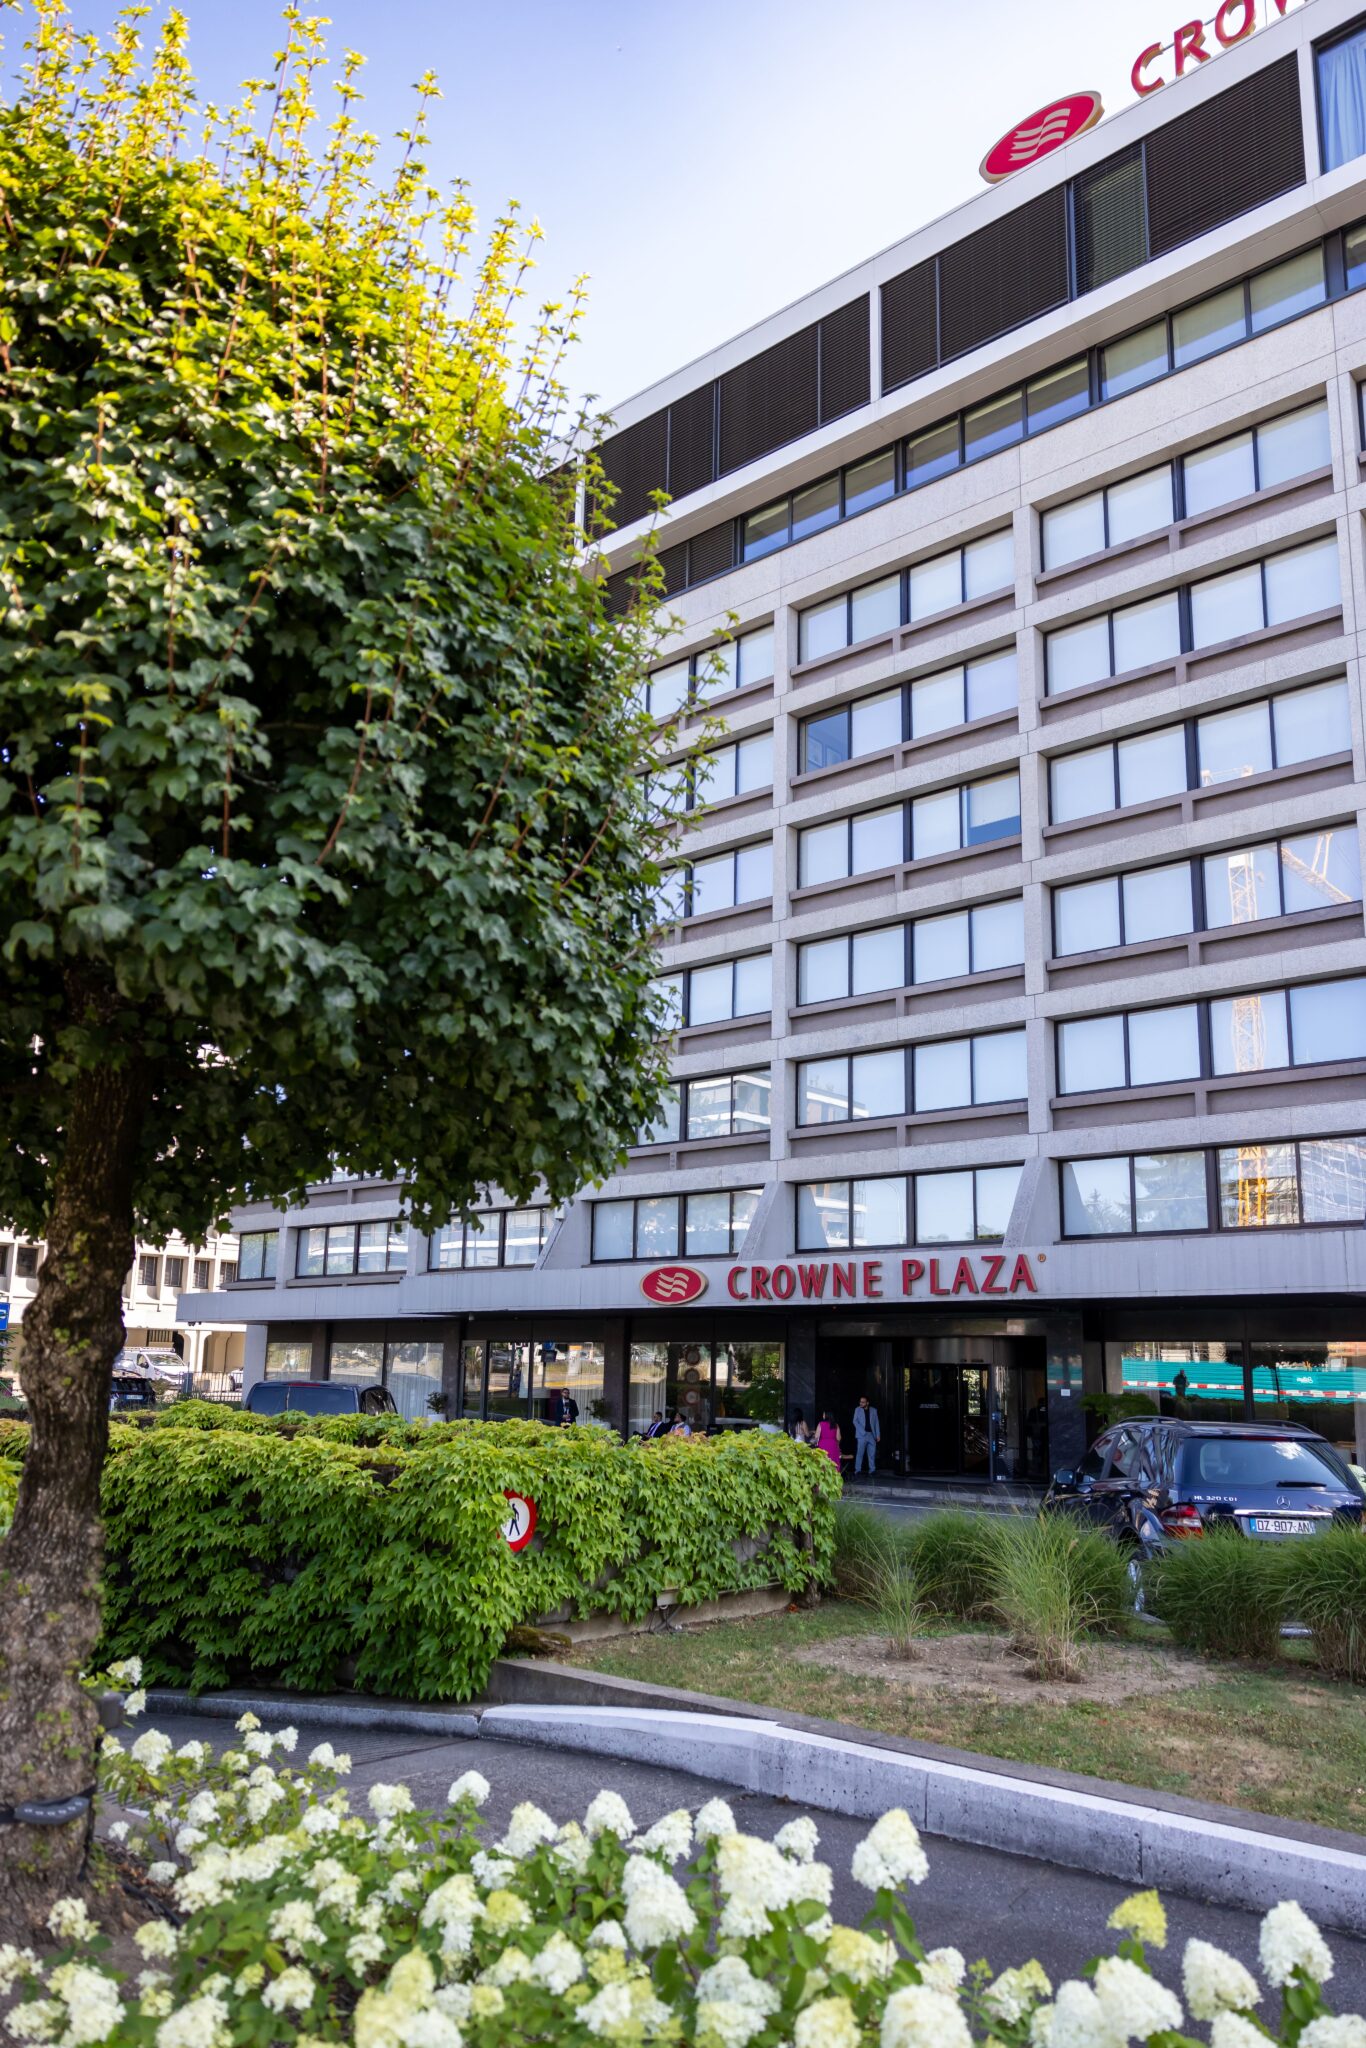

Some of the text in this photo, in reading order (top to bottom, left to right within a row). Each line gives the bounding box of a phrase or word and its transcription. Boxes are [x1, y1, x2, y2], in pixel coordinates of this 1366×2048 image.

[1130, 0, 1288, 98] CRO
[727, 1253, 1038, 1300] CROWNE PLAZA
